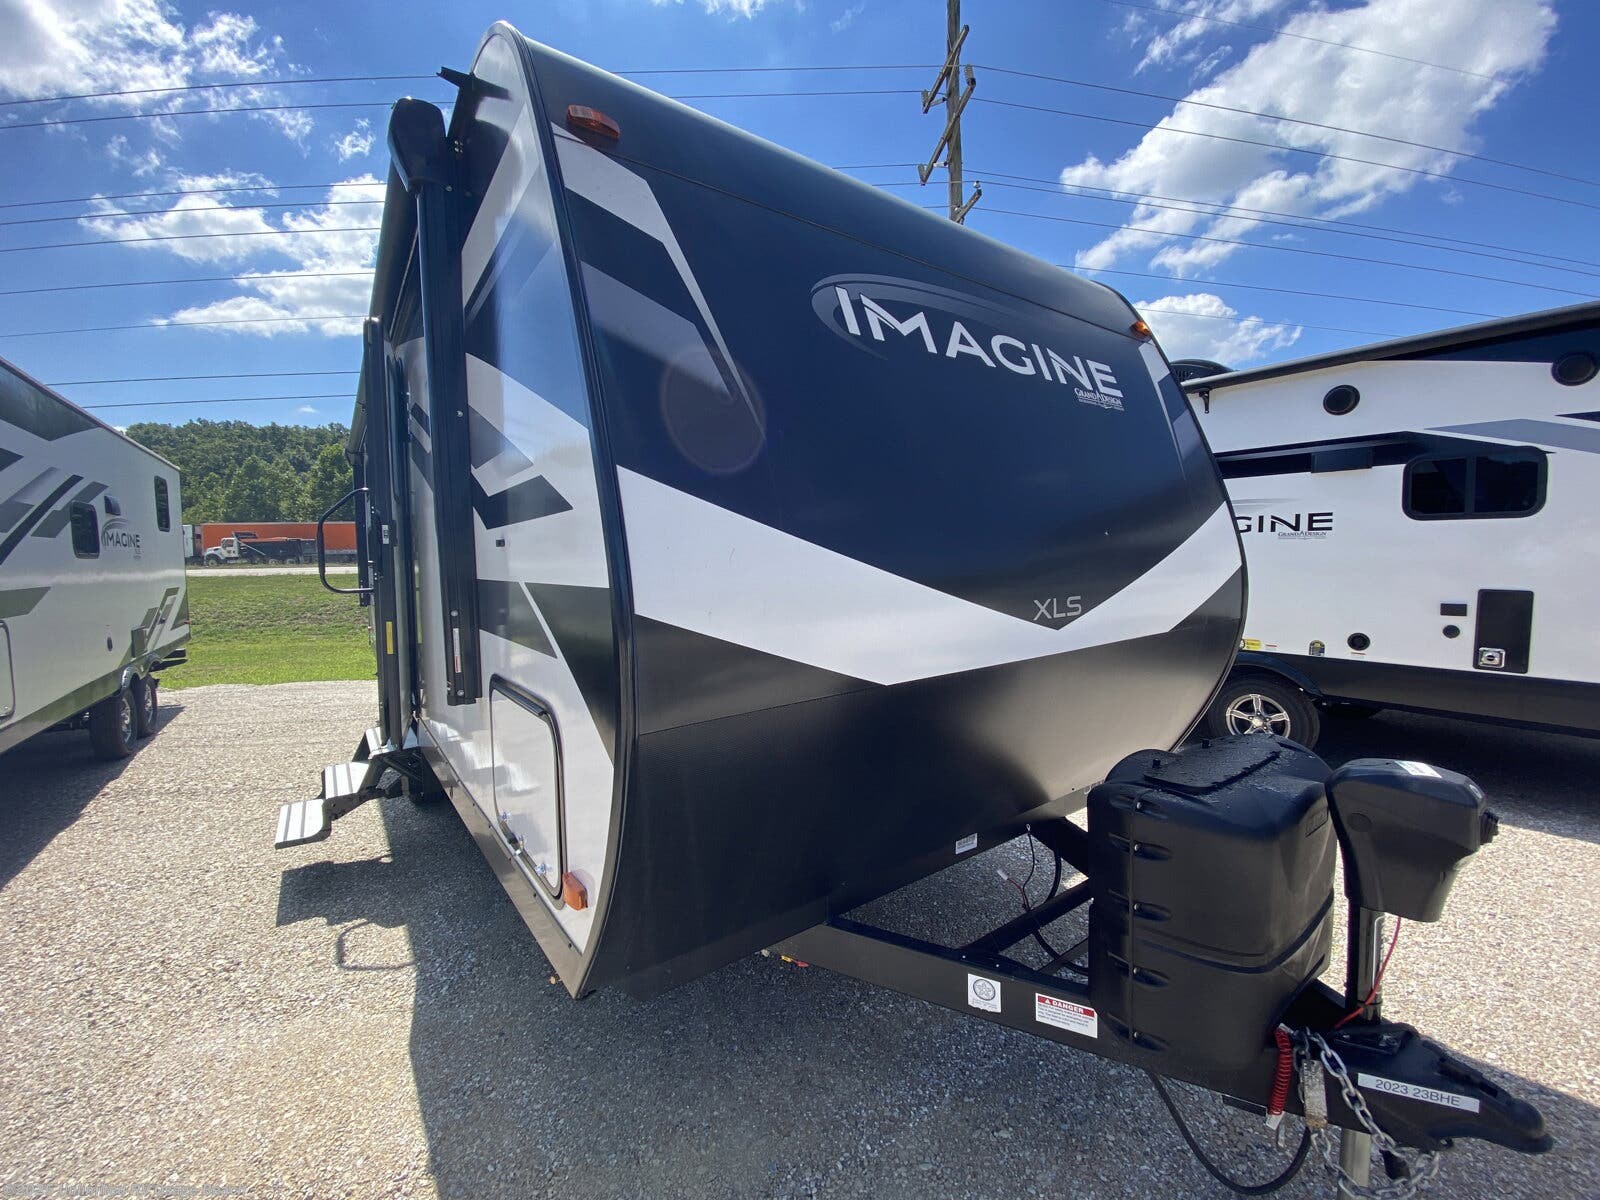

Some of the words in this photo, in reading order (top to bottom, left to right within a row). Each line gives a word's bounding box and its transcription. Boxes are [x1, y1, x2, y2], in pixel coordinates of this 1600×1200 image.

[834, 286, 1123, 398] IMAGINE
[1033, 595, 1082, 620] XLS
[1052, 1000, 1084, 1014] DANGER
[1375, 1079, 1409, 1095] 2023
[1412, 1087, 1461, 1107] 23BHE
